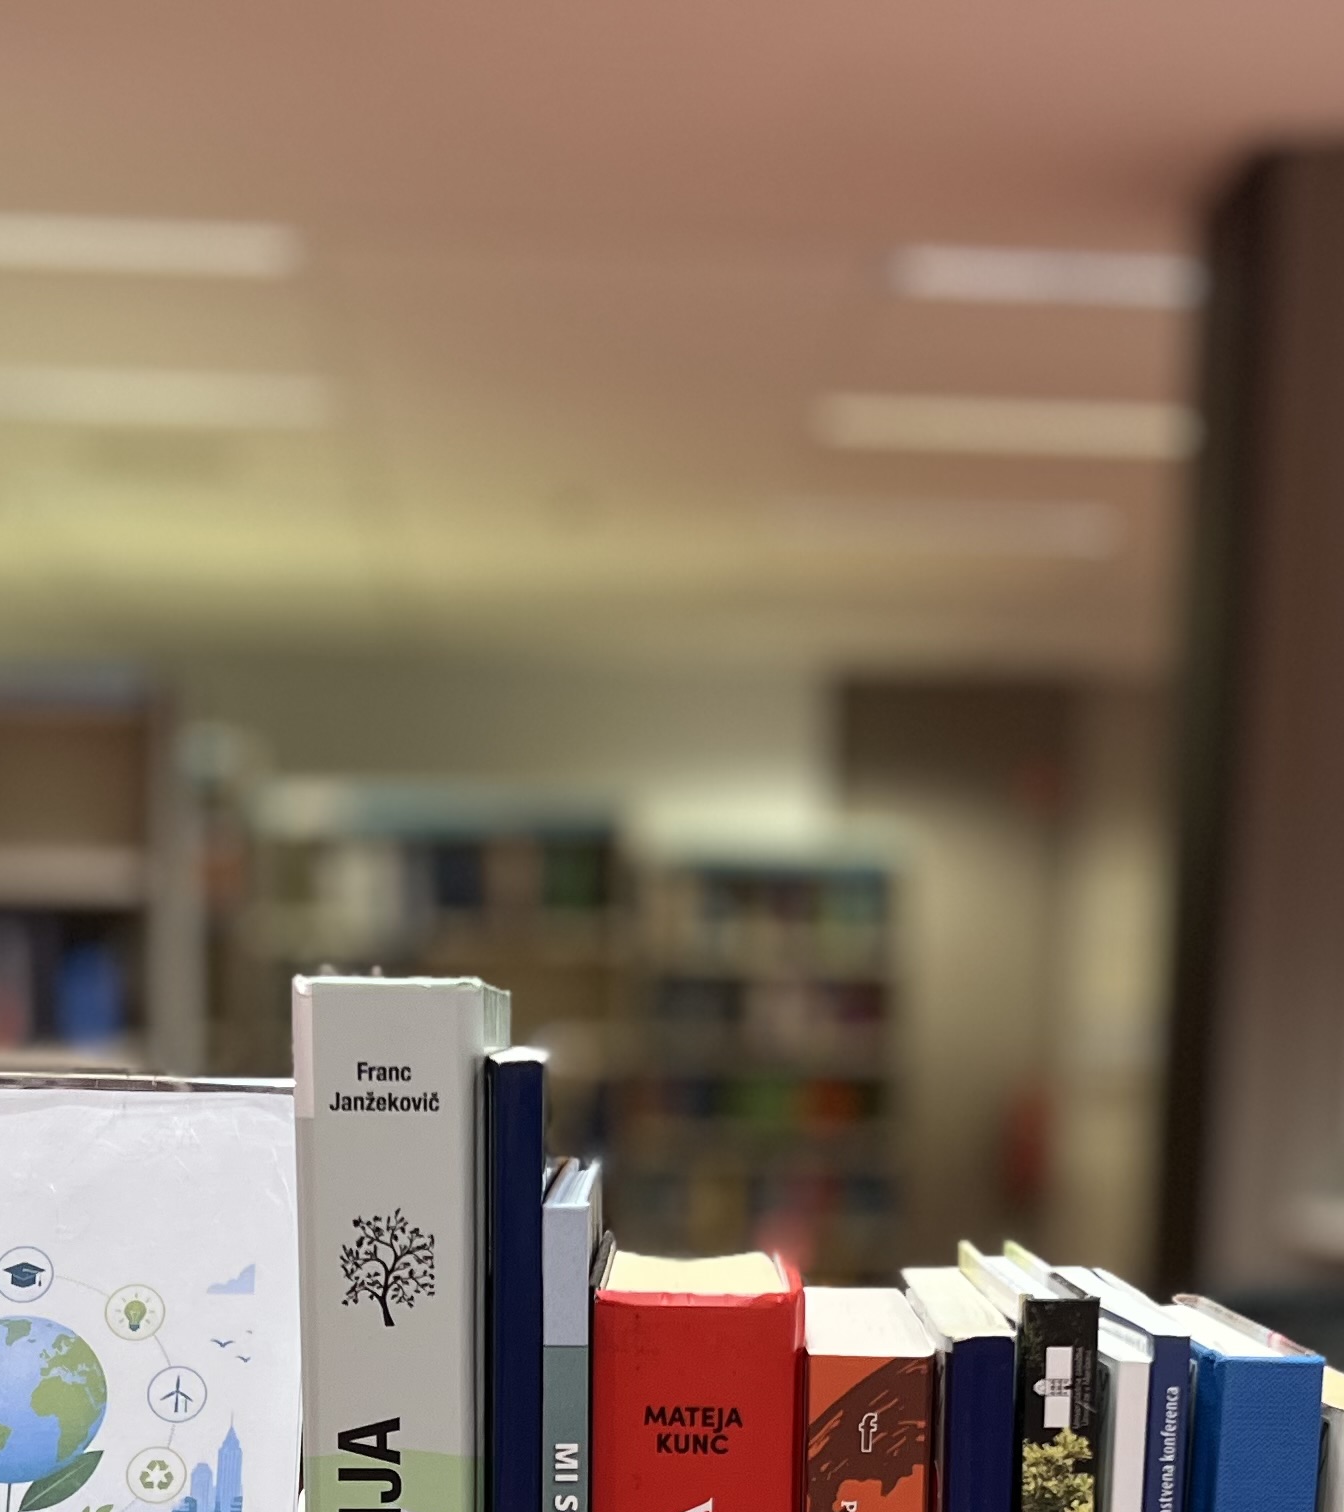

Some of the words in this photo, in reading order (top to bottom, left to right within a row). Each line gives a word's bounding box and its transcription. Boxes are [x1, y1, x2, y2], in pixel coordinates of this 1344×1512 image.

[357, 1061, 411, 1081] Franc
[329, 1091, 440, 1112] Janžekovič
[644, 1405, 743, 1435] MATEJA
[555, 1443, 578, 1481] MI
